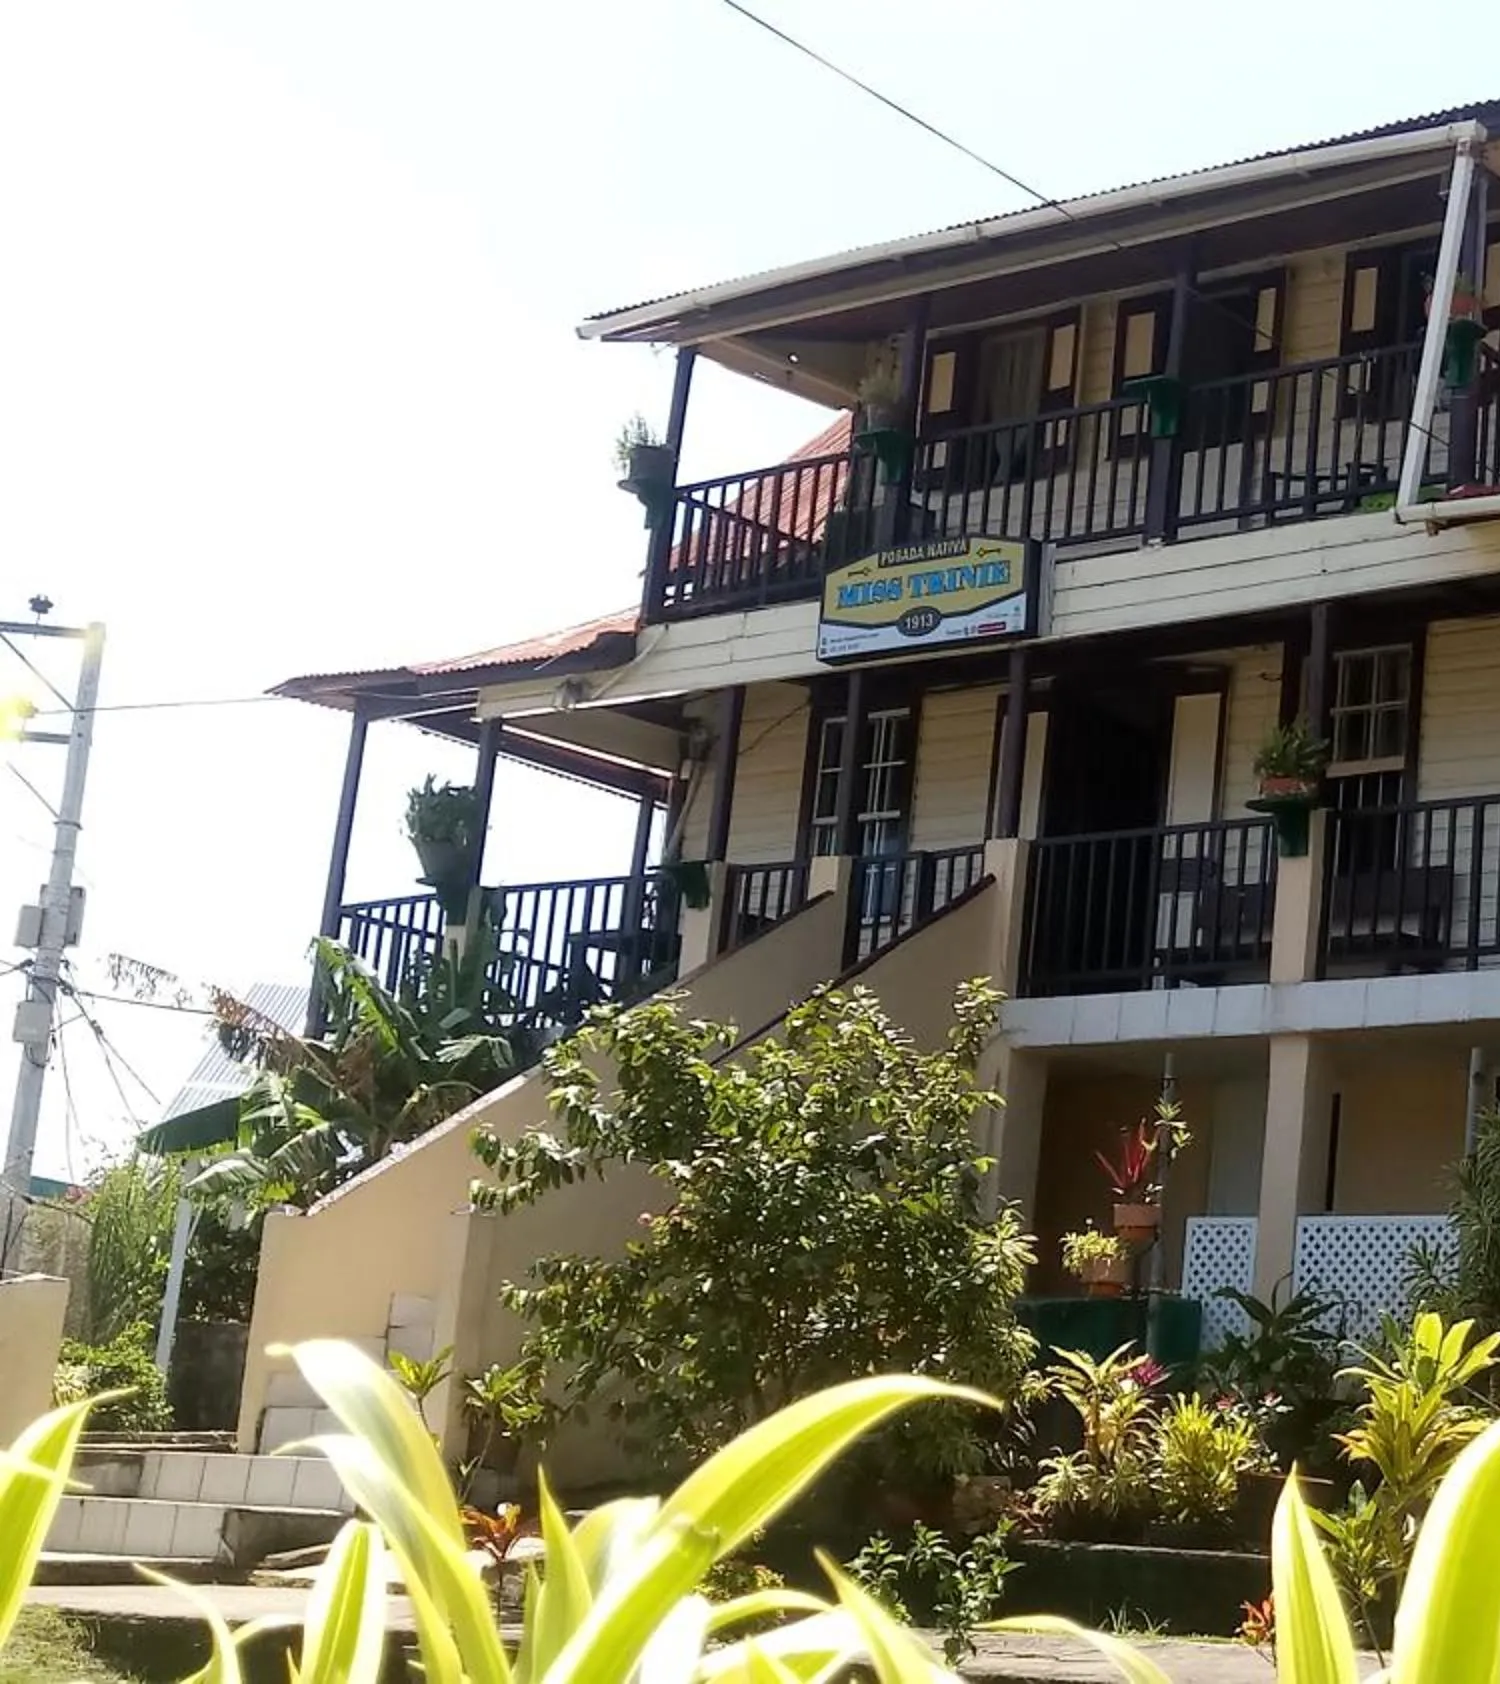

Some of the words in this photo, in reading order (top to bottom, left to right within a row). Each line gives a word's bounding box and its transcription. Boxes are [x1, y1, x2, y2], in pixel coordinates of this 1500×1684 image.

[880, 546, 925, 567] POSADA
[927, 538, 967, 558] NATIVA
[836, 576, 903, 609] MISS
[908, 560, 1011, 598] TRINIE
[906, 614, 934, 630] 1913
